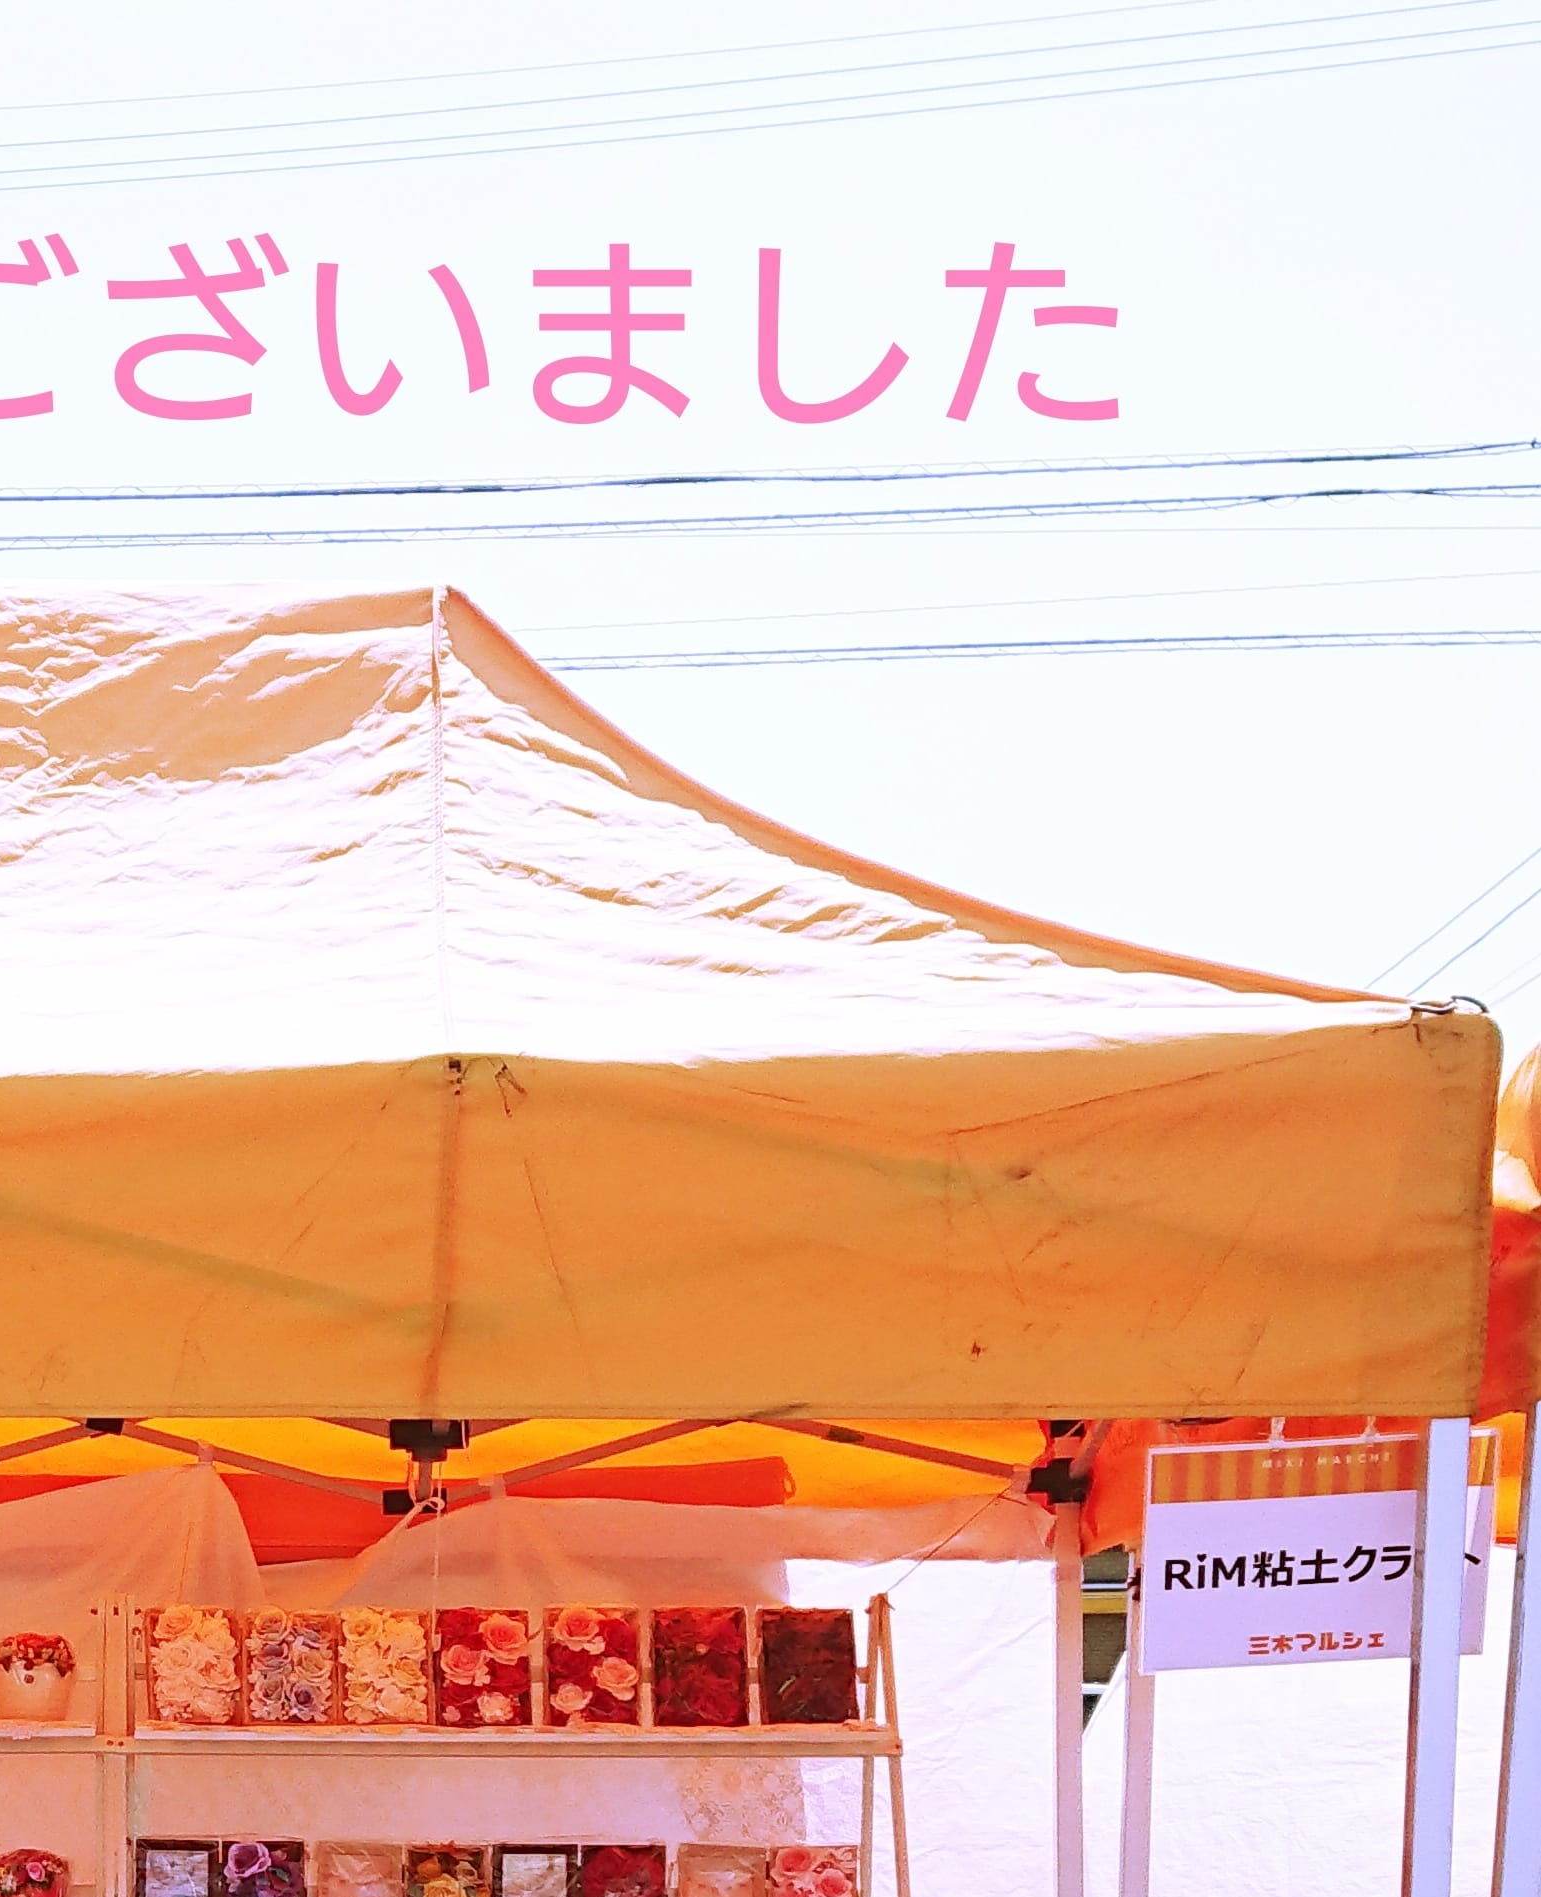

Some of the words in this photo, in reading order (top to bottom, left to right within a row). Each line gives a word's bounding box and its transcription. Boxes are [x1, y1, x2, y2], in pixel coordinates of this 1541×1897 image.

[1162, 1544, 1482, 1591] RiM粘土クラ
[1247, 1631, 1385, 1656] 三木マルシェ
